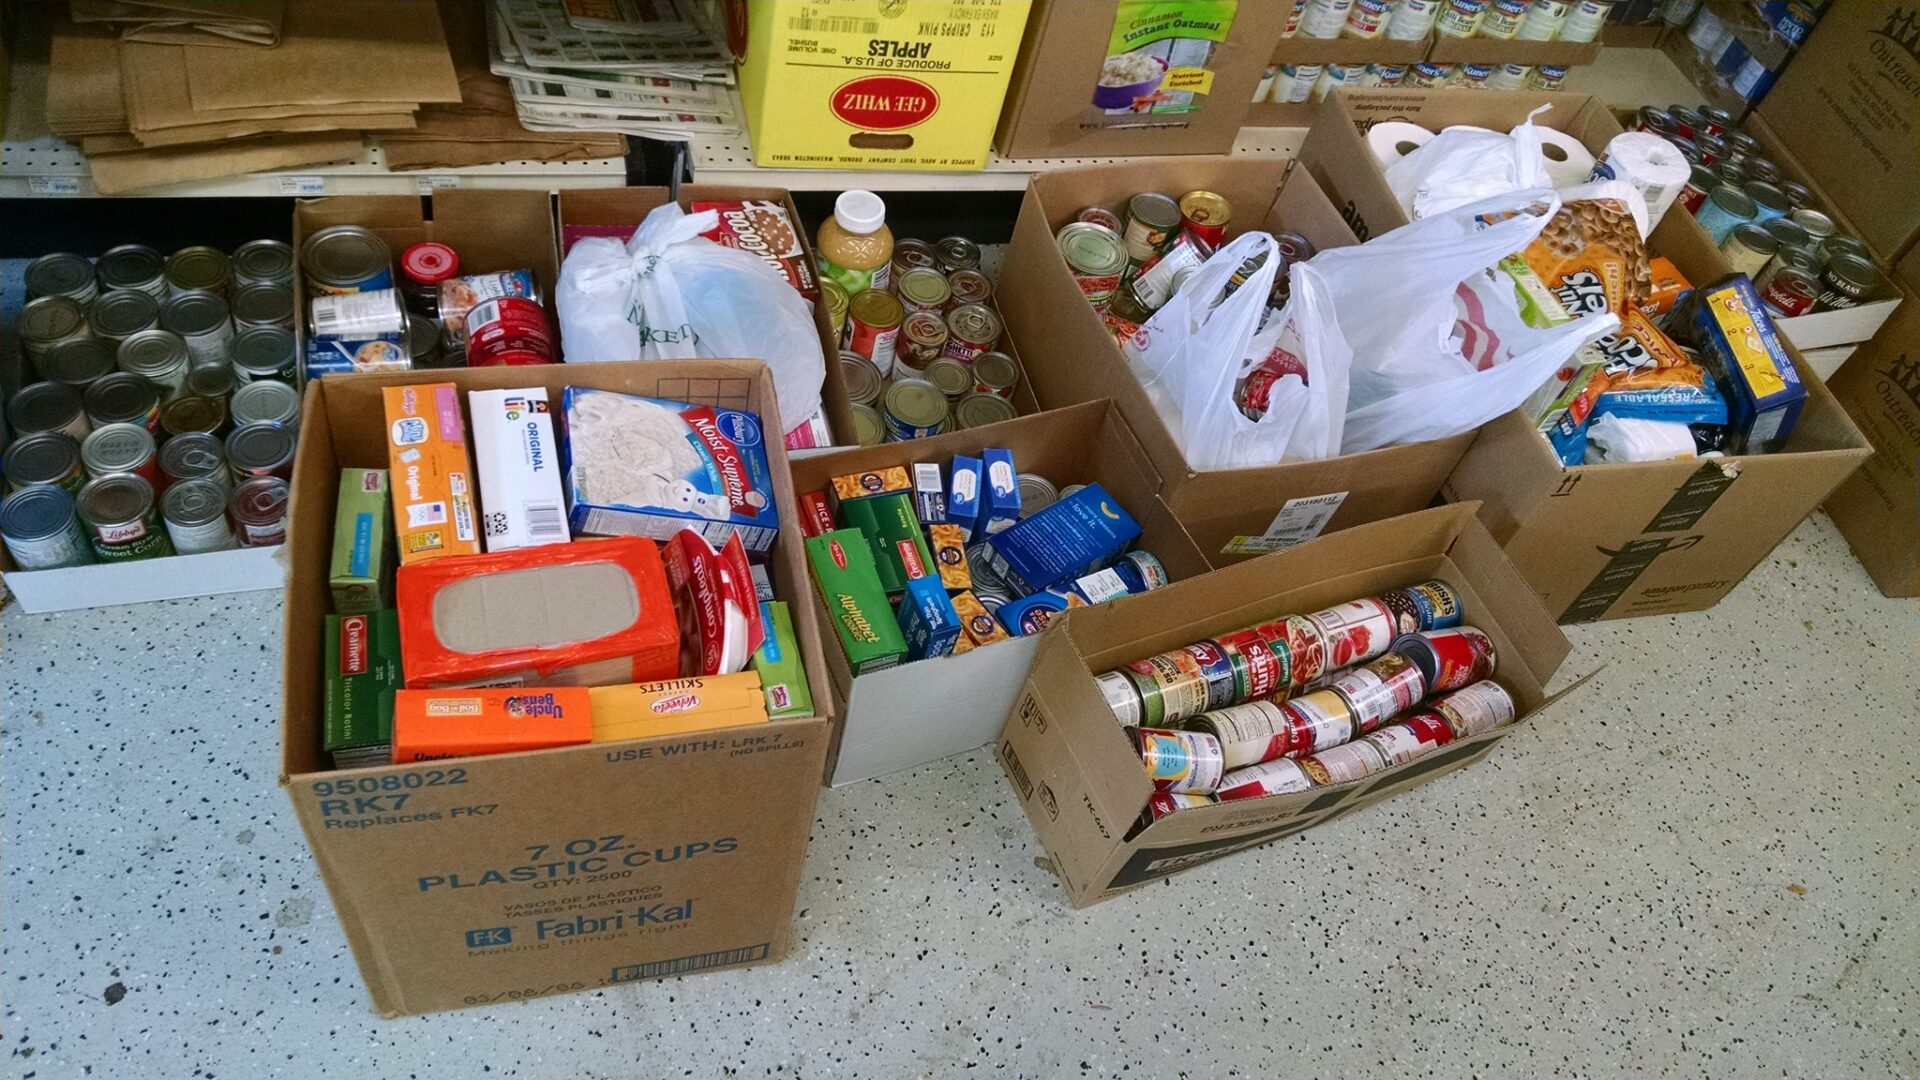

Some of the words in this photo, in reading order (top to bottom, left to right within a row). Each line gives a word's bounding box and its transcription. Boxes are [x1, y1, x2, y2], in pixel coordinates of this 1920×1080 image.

[918, 21, 940, 36] PINK
[940, 22, 971, 37] CRIPPS
[1122, 21, 1170, 44] Instant
[1172, 18, 1221, 32] Oatmeal
[1129, 10, 1184, 31] Cinnamon
[841, 55, 875, 66] U.S.A.
[867, 39, 932, 59] APPLES
[876, 57, 894, 68] OF
[895, 58, 951, 70] PRODUCE
[842, 93, 891, 112] WHIZ
[894, 95, 927, 113] GEE
[1836, 279, 1861, 295] BEANS
[1749, 308, 1767, 333] Tacos
[1614, 391, 1691, 404] RESEALABLE
[688, 417, 729, 453] Moist
[731, 414, 746, 445] Pillsbury
[526, 422, 544, 472] ORIGINAL
[406, 465, 423, 500] Original
[815, 501, 830, 524] RICE
[1071, 502, 1090, 521] love
[901, 542, 925, 580] Creamette
[693, 555, 720, 638] Compleats
[1427, 582, 1455, 616] BUSH'S
[836, 593, 881, 644] Alphabet
[345, 618, 362, 672] Creamette
[1249, 644, 1267, 697] Hunt's
[344, 677, 354, 713] Tricolor
[640, 678, 704, 695] SKILLETS
[526, 703, 563, 719] Uncle
[651, 695, 698, 713] Velveeta
[344, 715, 353, 740] Rotini
[605, 748, 653, 764] USE
[660, 739, 725, 757] WITH:
[731, 735, 768, 749] LRK
[772, 733, 784, 743] 7
[730, 747, 755, 759] (NO
[756, 740, 805, 754] SPILLS)
[311, 767, 469, 798] 9508022
[319, 793, 411, 817] RK7
[323, 810, 442, 831] Replaces
[449, 803, 499, 819] FK7
[1082, 792, 1111, 839] TK-667
[525, 844, 549, 862] 7
[564, 834, 637, 858] OZ.
[417, 856, 609, 893] PLASTIC
[622, 836, 739, 867] CUPS
[532, 876, 581, 891] QTY:
[586, 869, 633, 885] 2500
[503, 899, 557, 912] VASOS
[586, 884, 663, 901] PLASTICO
[503, 905, 564, 920] TASSES
[567, 892, 664, 911] PLASTIQUES
[535, 898, 694, 941] Fabri-Kal
[467, 940, 551, 959] Making
[559, 930, 630, 947] things
[638, 921, 690, 937] right
